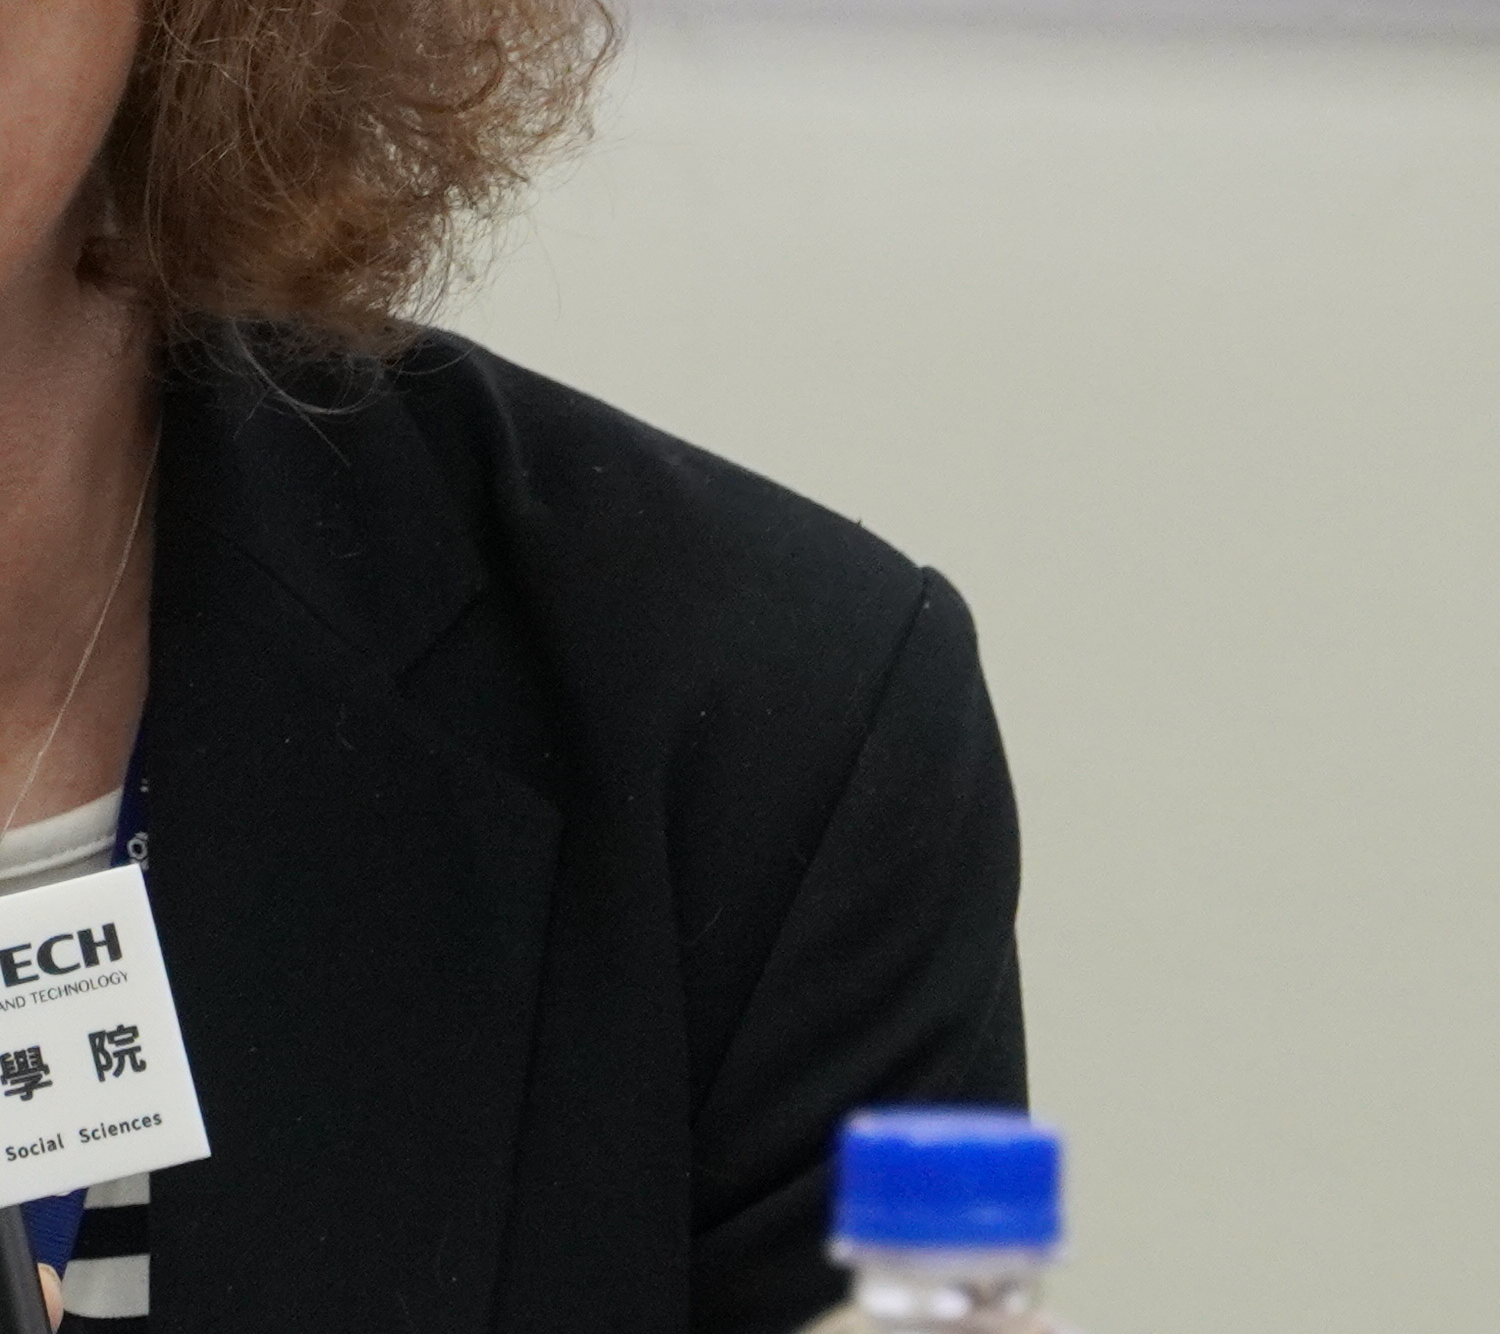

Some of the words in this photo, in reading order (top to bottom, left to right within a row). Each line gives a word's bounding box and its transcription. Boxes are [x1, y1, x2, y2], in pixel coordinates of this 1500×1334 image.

[29, 970, 129, 1005] TECHNOLOGY
[5, 1133, 65, 1162] Social
[78, 1112, 163, 1145] Sciences
